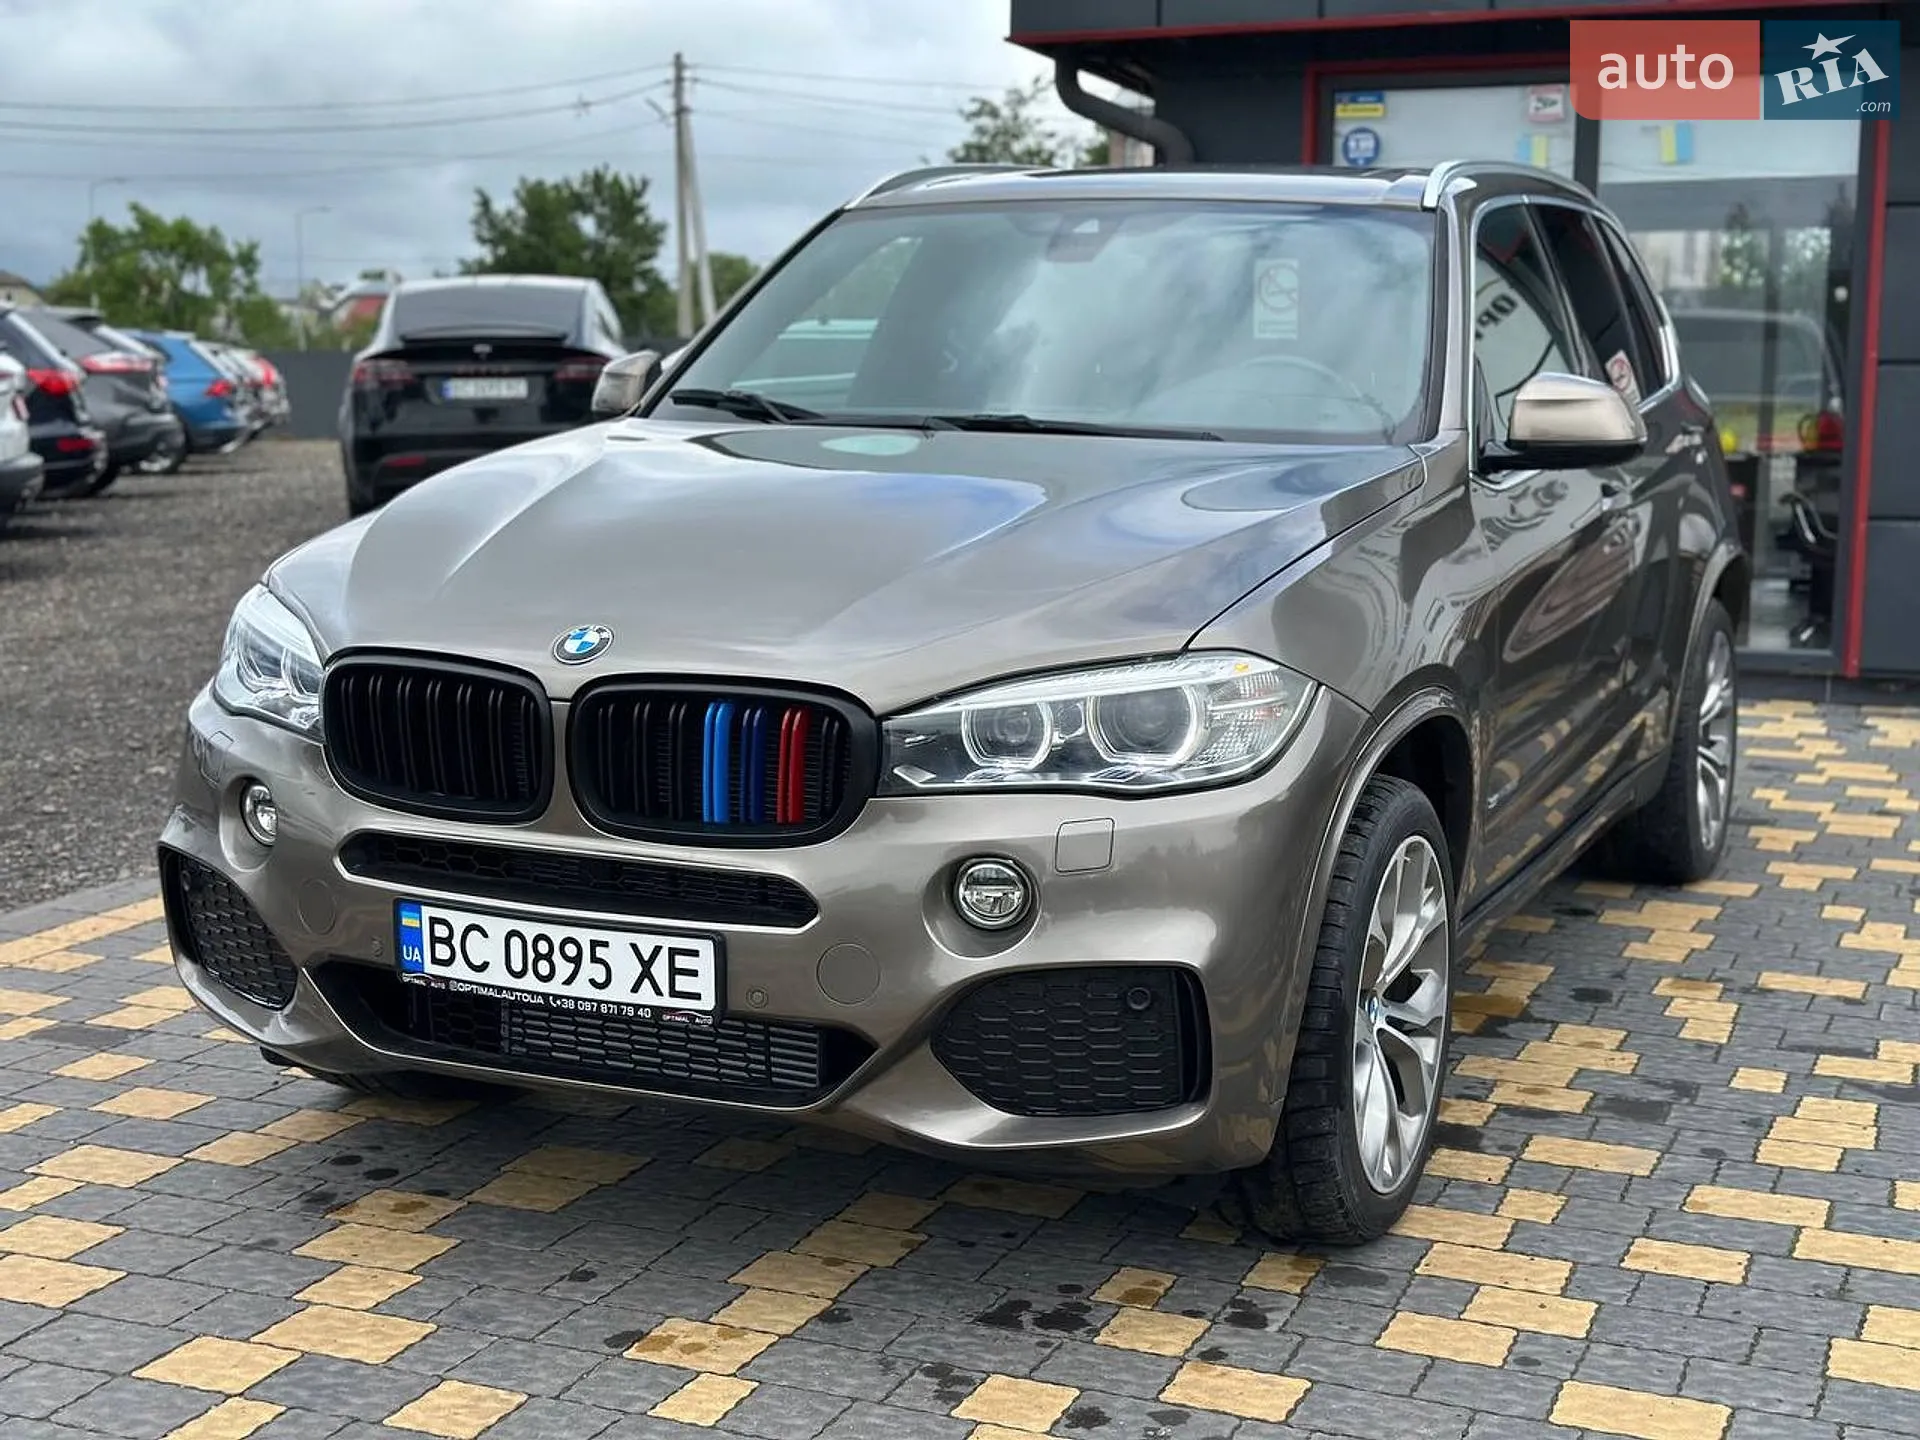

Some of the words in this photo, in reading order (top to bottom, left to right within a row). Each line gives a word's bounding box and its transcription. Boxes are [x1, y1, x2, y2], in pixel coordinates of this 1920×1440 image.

[402, 944, 422, 963] UA
[428, 915, 490, 973] BC
[504, 928, 613, 990] 0895
[628, 942, 702, 1001] XE
[577, 1000, 598, 1012] 097
[637, 1007, 652, 1018] 40
